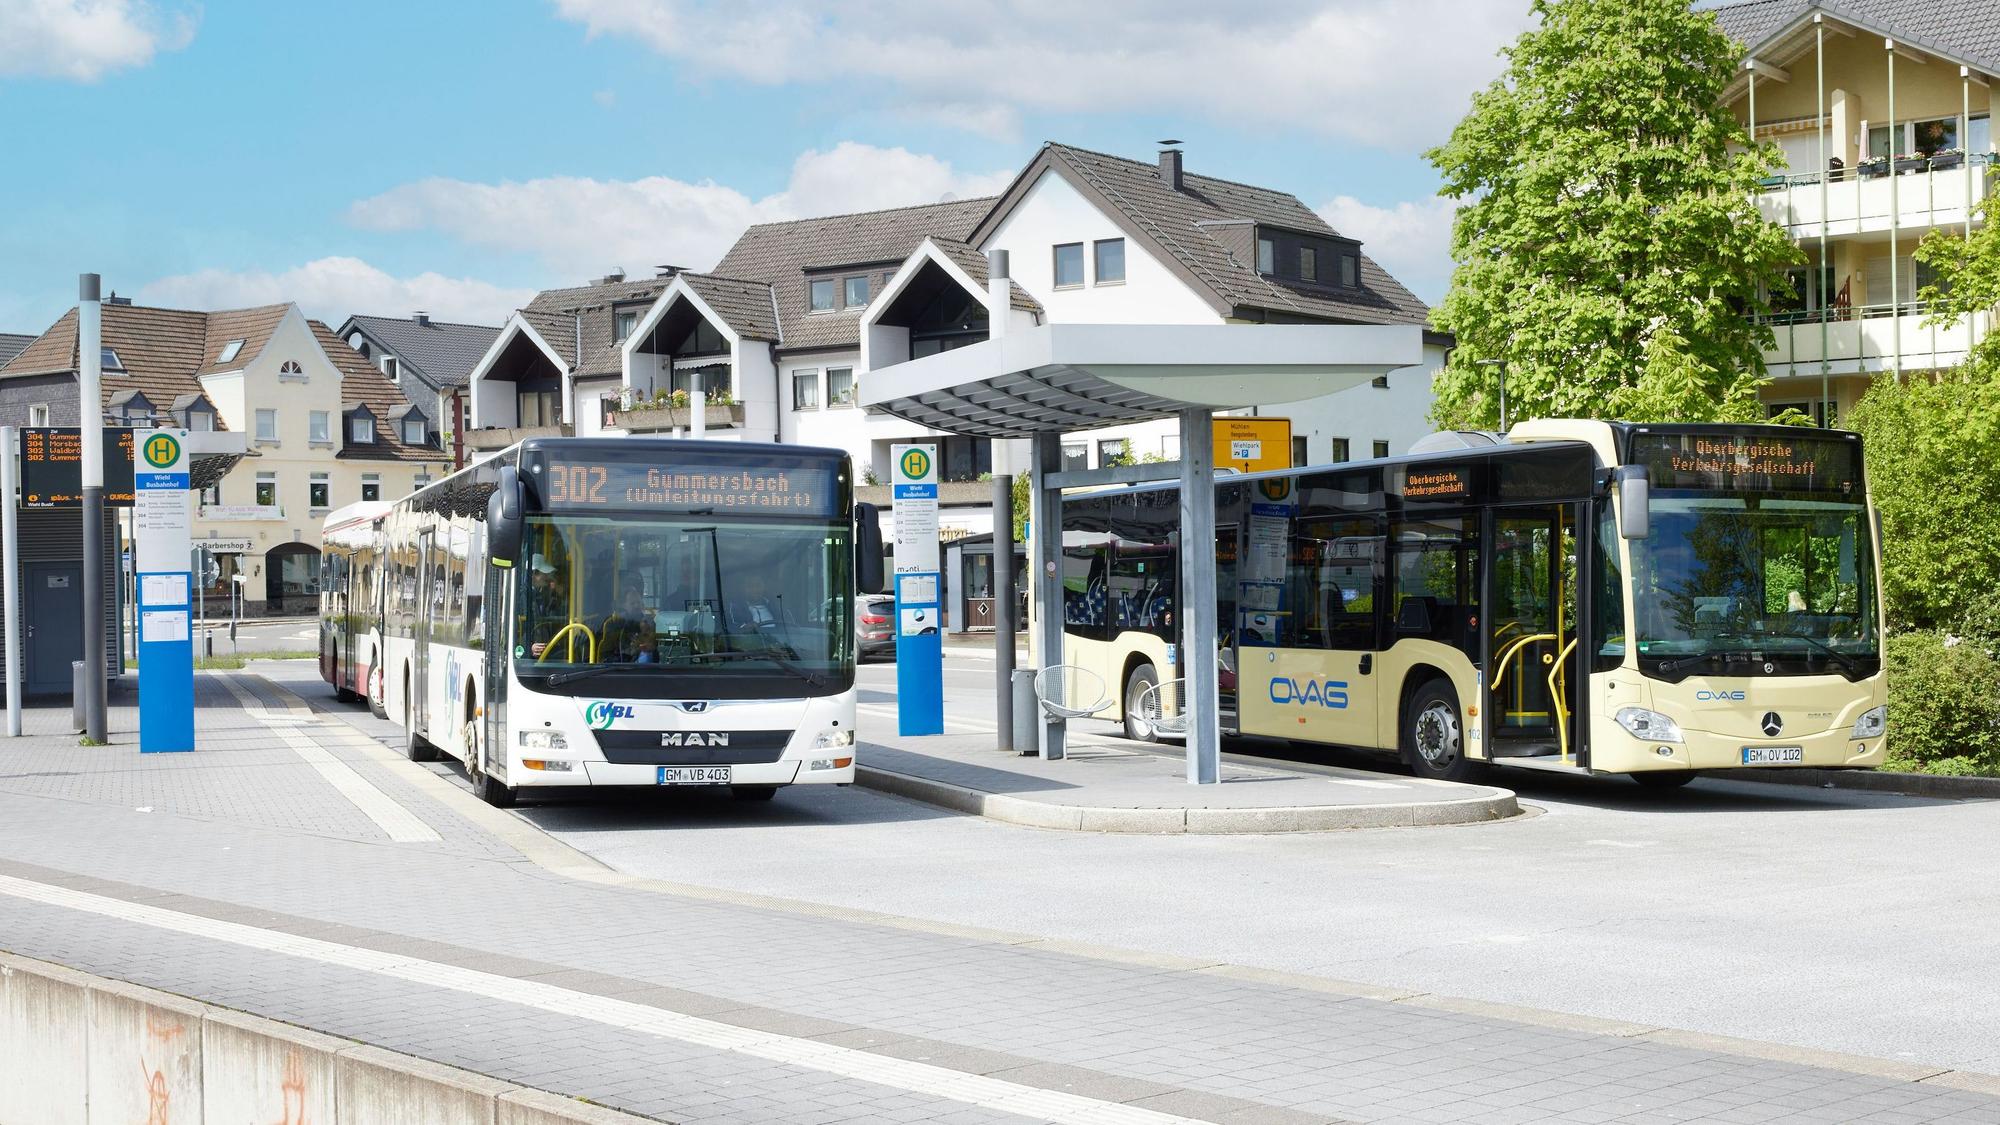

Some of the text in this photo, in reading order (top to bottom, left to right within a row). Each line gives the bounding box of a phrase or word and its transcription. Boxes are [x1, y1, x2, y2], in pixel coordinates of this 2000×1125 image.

[49, 446, 81, 454] Waldbrö
[154, 441, 169, 461] H
[1696, 441, 1792, 458] Oberbergische
[909, 455, 922, 473] H
[1672, 456, 1816, 475] Verkehrsgesellschaft
[550, 465, 789, 502] 302 Gummersbach
[1409, 472, 1457, 484] Oberbergische
[625, 488, 811, 506] (Umleitungsfahrt)
[1403, 482, 1464, 496] Verkehrsgesellschaft
[1269, 677, 1349, 709] OVAG
[1696, 690, 1745, 701] OVAG
[599, 702, 635, 719] VBL
[661, 732, 729, 747] MAN
[1468, 728, 1481, 740] 102
[1750, 749, 1801, 761] GM OV 102
[666, 769, 729, 781] GM VB 403
